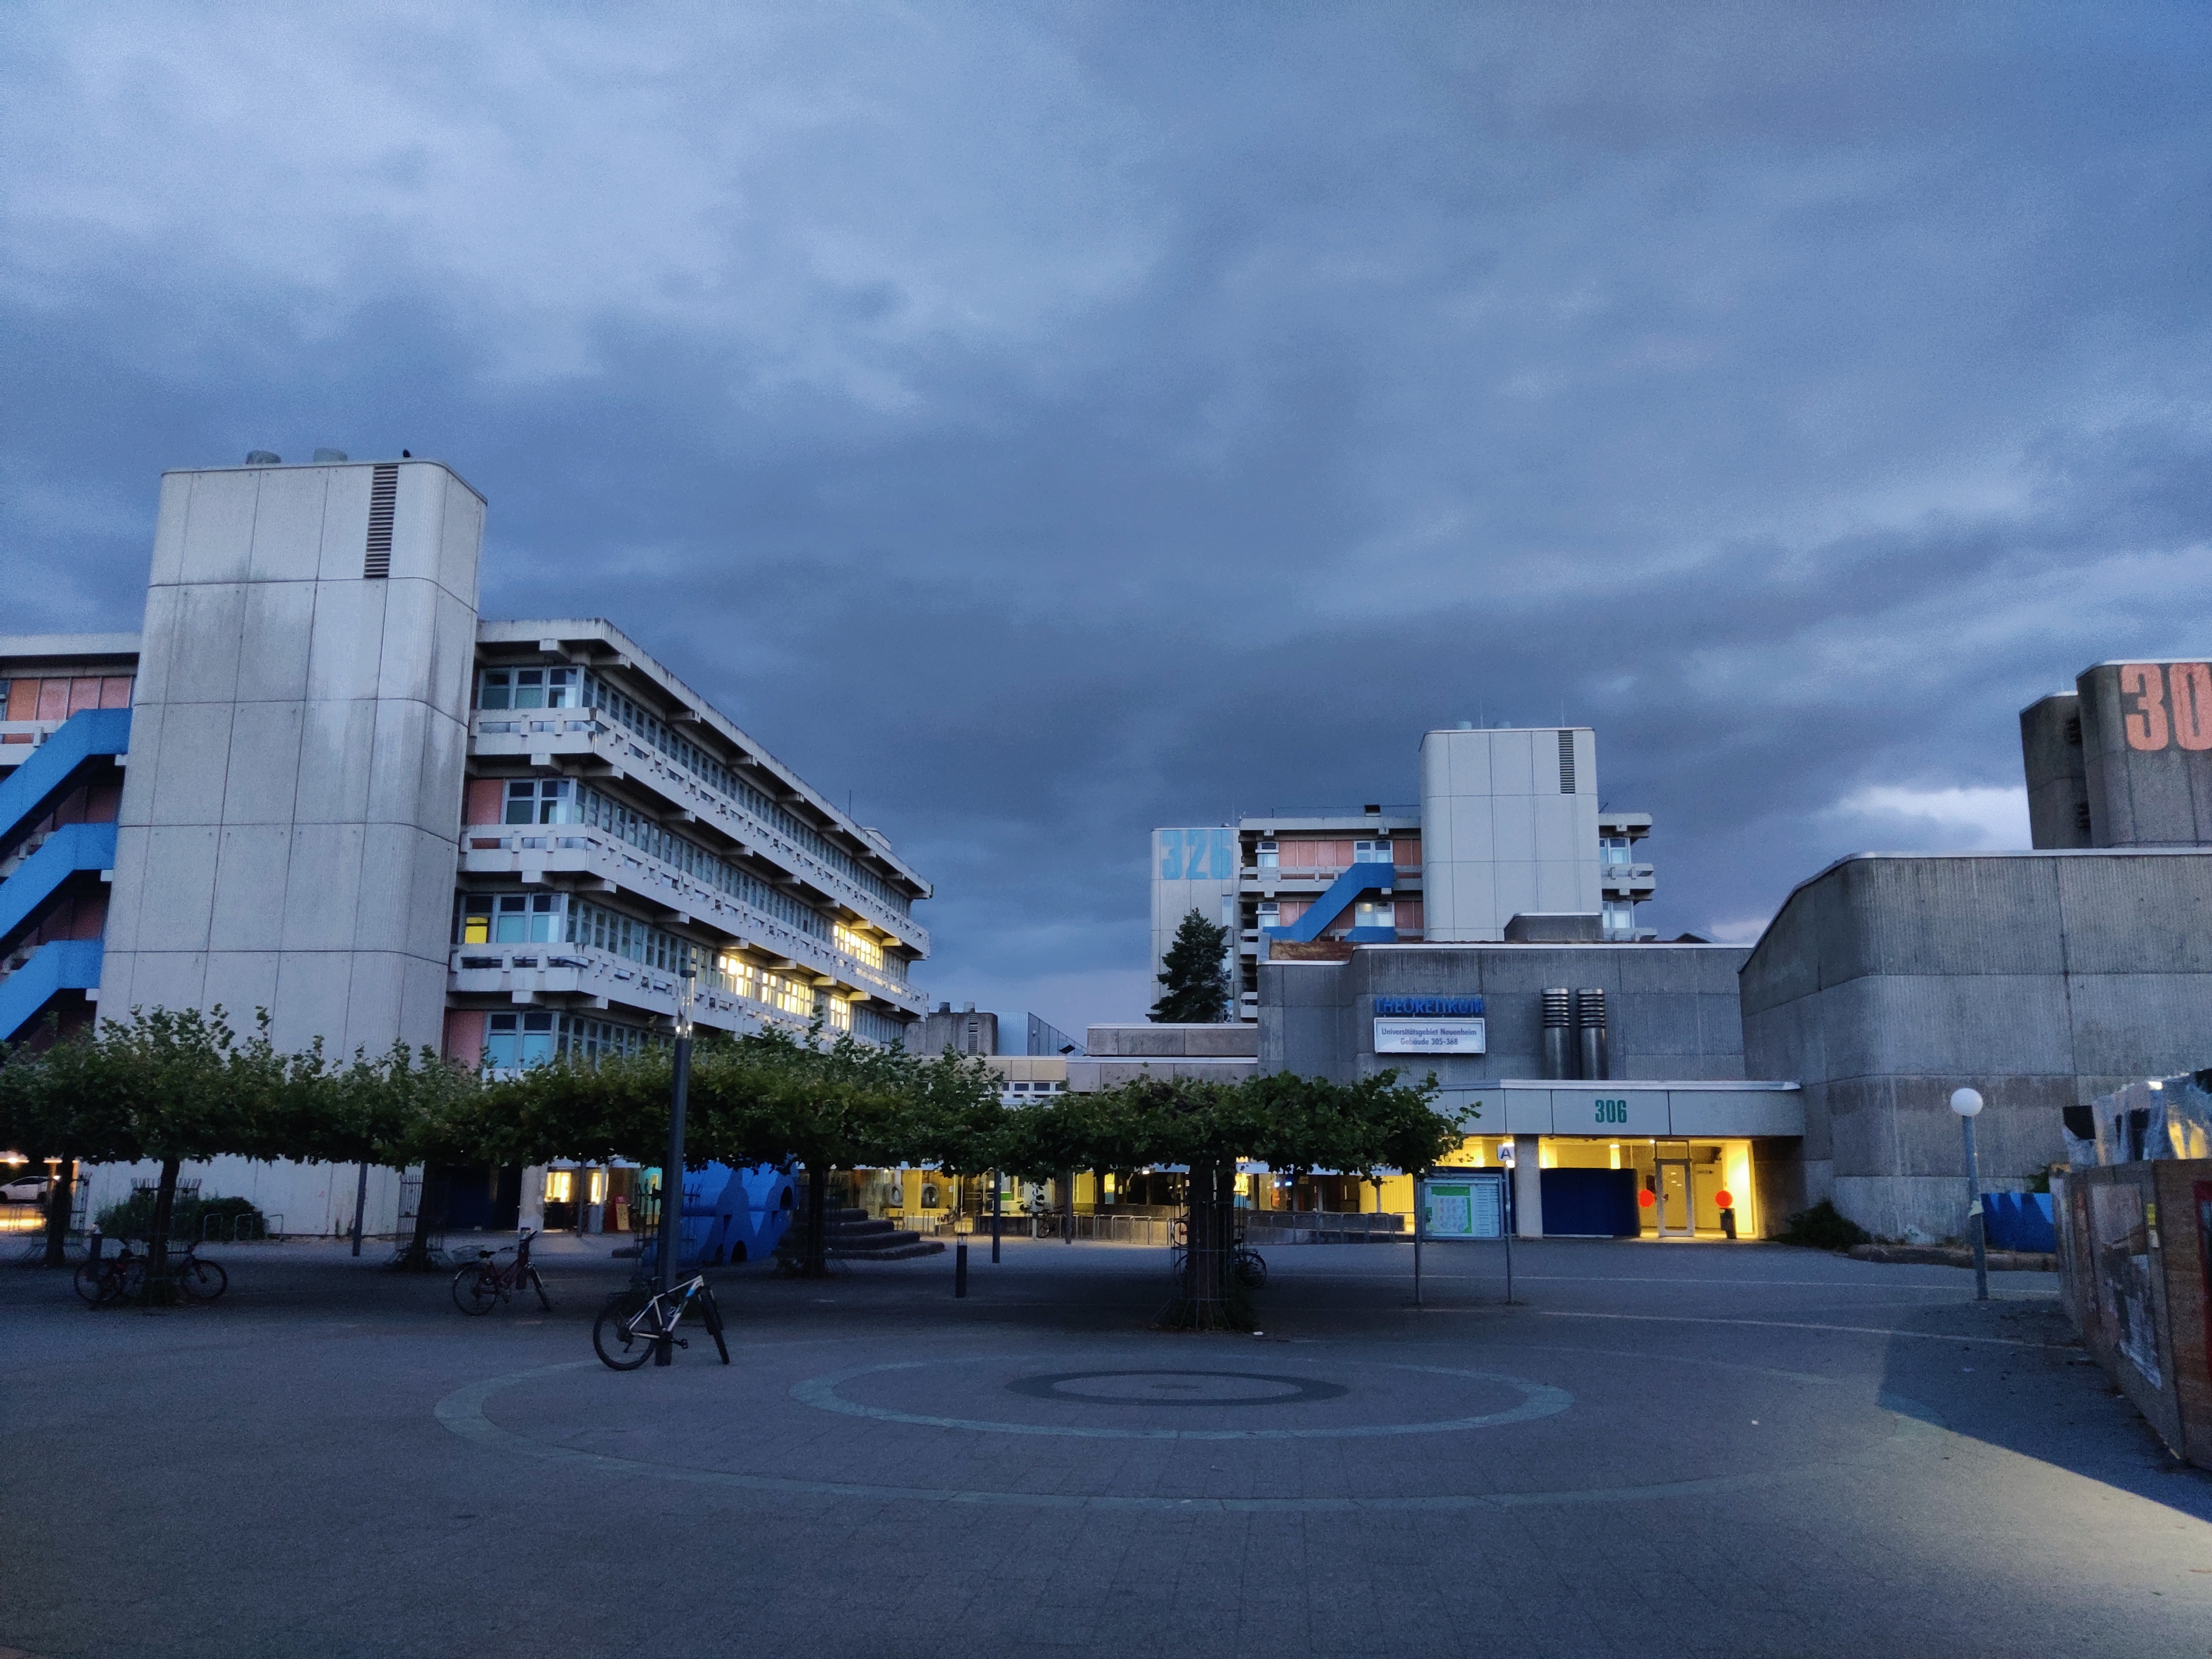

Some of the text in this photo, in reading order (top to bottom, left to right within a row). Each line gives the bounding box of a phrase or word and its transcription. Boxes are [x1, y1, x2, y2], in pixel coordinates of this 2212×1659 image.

[1161, 830, 1233, 879] 326
[1375, 998, 1484, 1014] THEORETIKUM
[1381, 1027, 1438, 1037] Universitätsgebiet
[1595, 1099, 1627, 1123] 306
[1500, 1146, 1512, 1160] A
